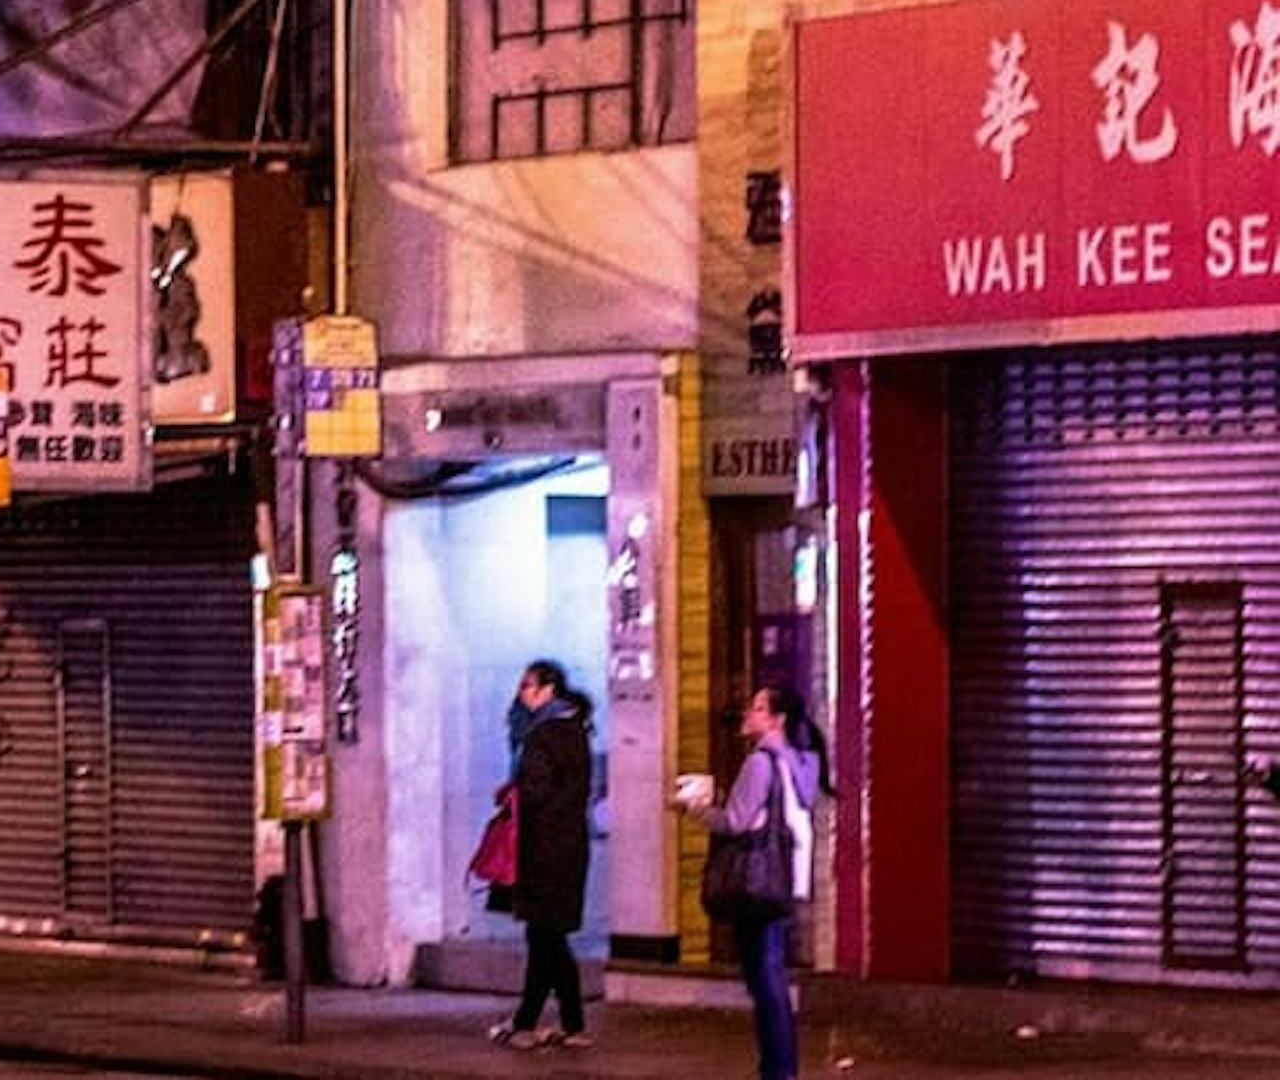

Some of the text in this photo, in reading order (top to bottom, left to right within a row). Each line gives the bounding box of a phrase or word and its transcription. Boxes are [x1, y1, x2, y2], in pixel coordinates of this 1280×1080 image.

[944, 214, 1280, 296] WAH KEE SE
